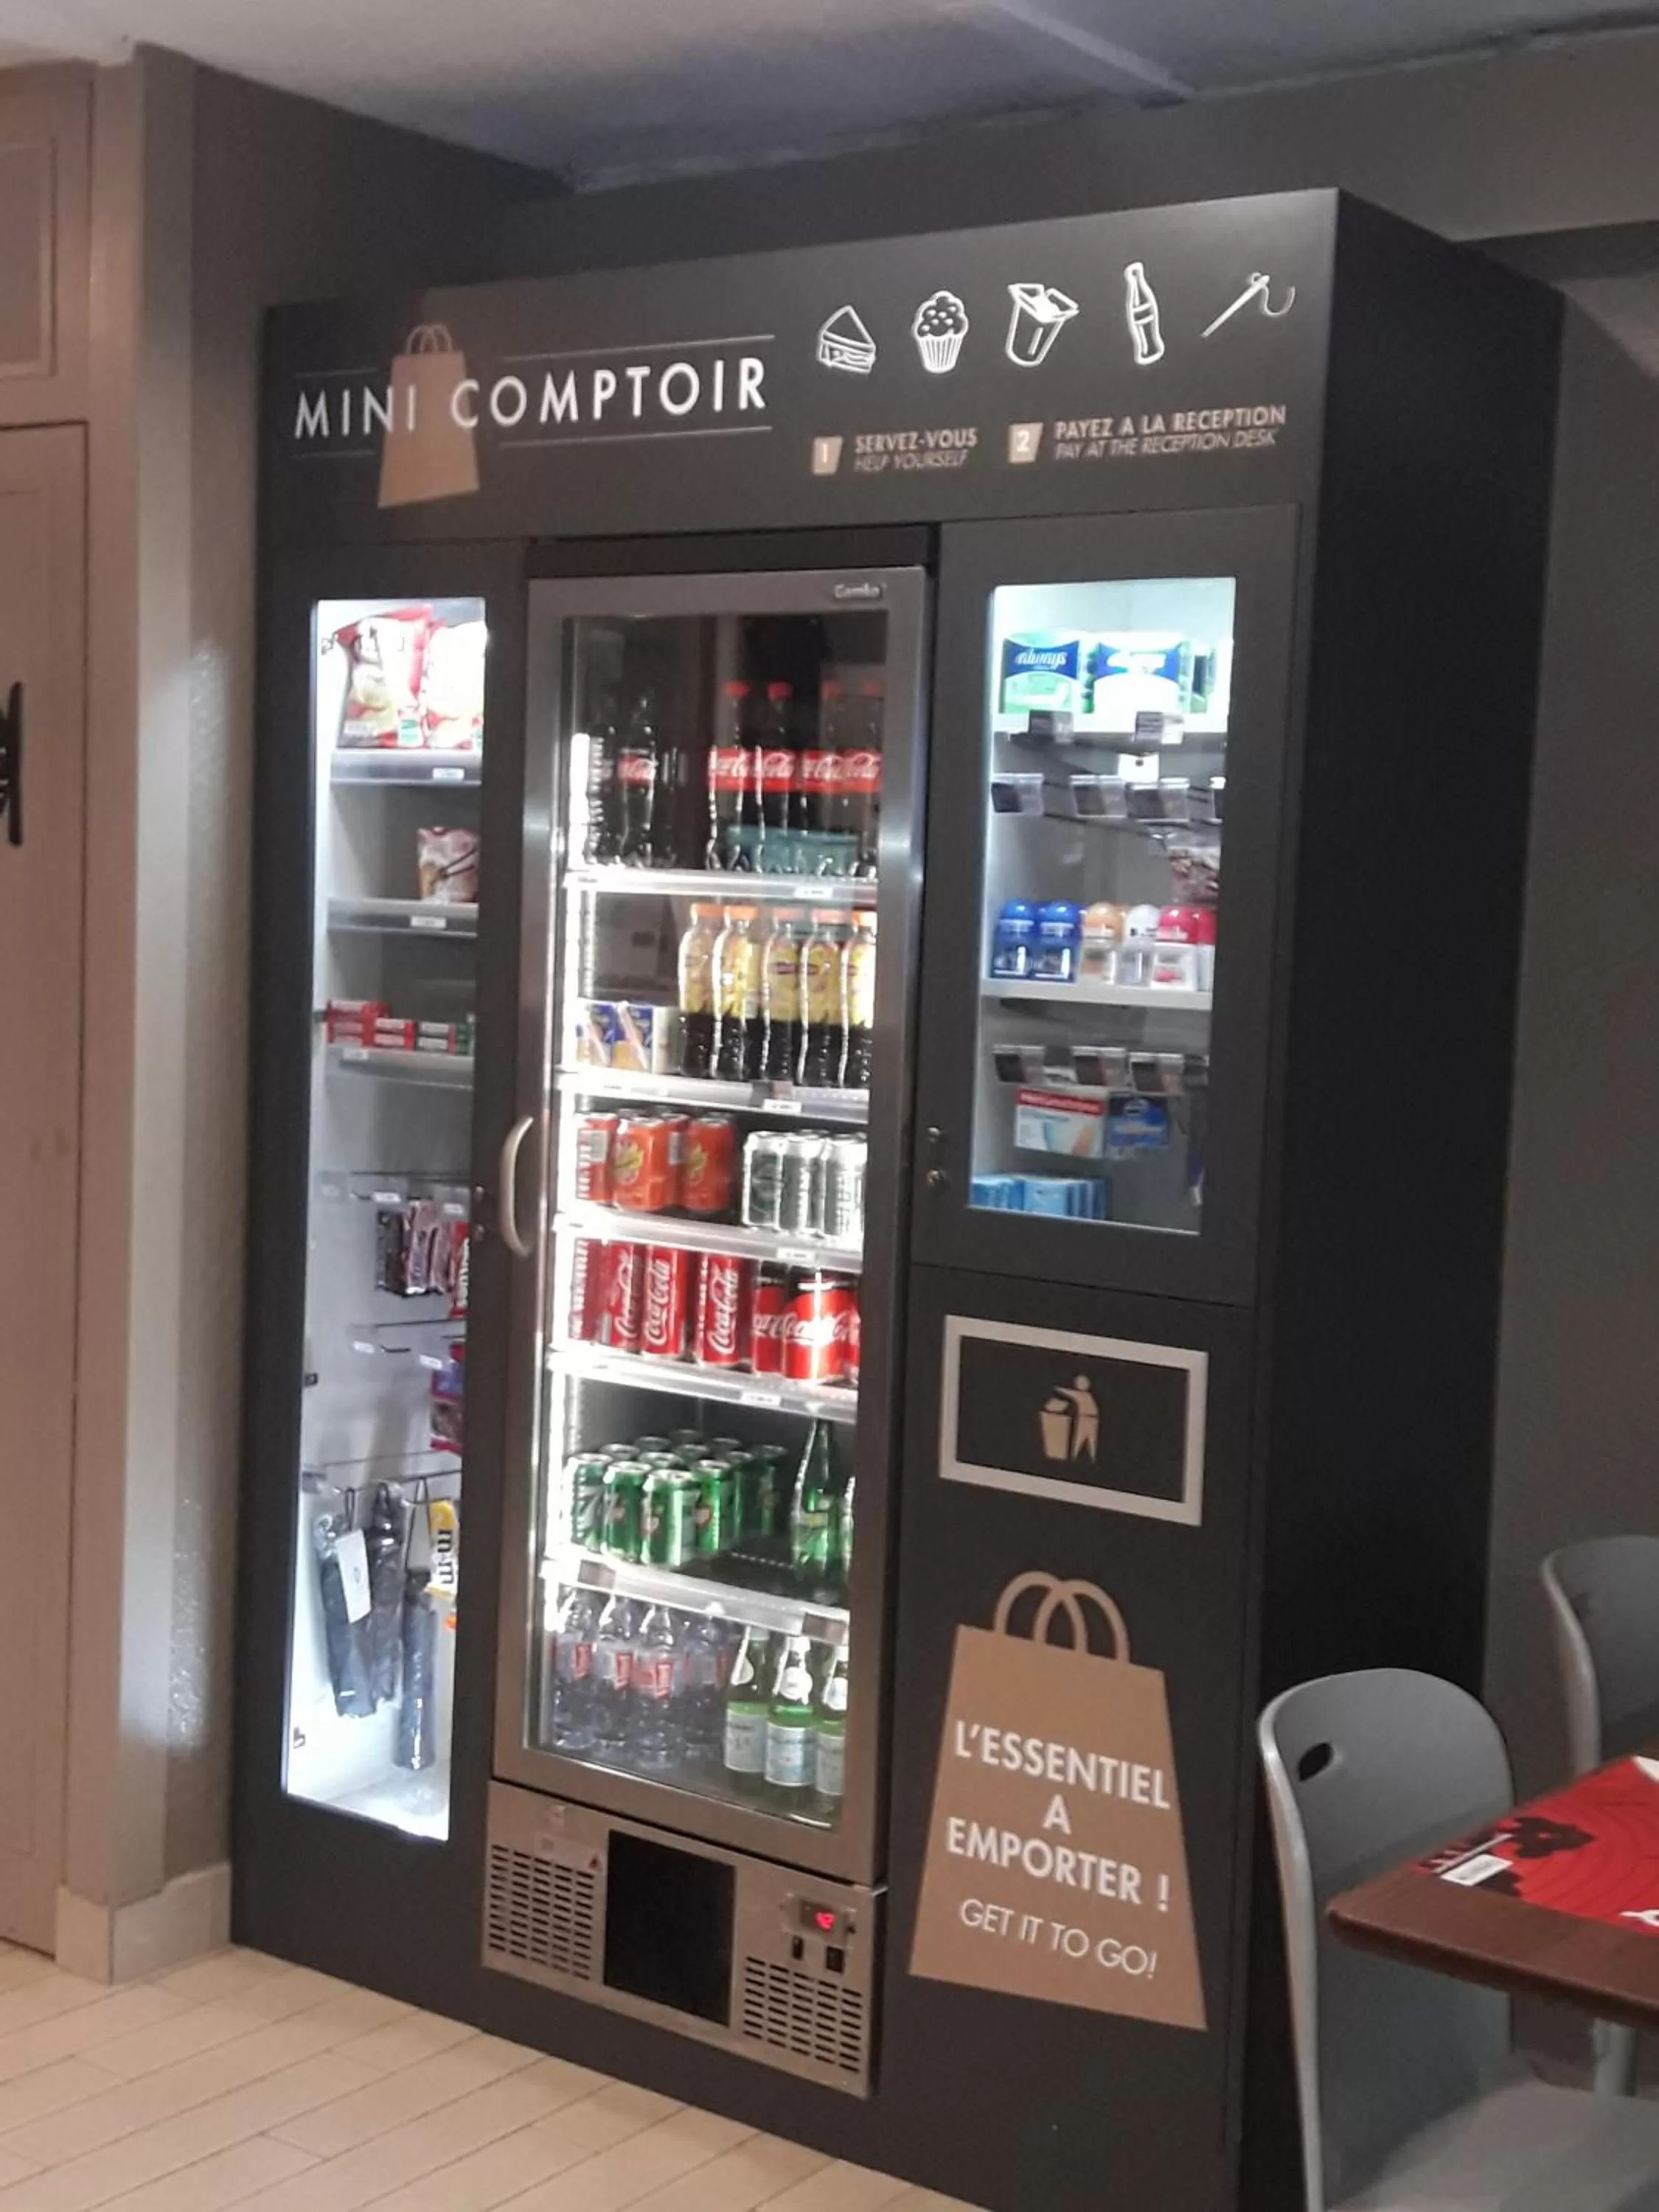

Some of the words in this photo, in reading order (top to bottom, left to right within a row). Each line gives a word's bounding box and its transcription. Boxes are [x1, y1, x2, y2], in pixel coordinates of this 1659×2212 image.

[296, 385, 417, 439] MINI
[450, 357, 765, 428] COMPTOIR
[1054, 417, 1113, 440] PAYEZ
[1119, 416, 1135, 437] A
[1141, 413, 1167, 434] LA
[1172, 404, 1286, 432] RECEPTION
[855, 426, 978, 453] SERVEZ-VOUS
[1110, 437, 1139, 456] THE
[955, 1719, 1170, 1809] L'ESSENTIEL
[1042, 1794, 1071, 1834] A
[947, 1816, 1142, 1905] EMPORTER
[961, 1898, 1015, 1936] GET
[1018, 1914, 1043, 1945] IT
[1051, 1922, 1090, 1958] TO
[1096, 1937, 1158, 1979] GO!
